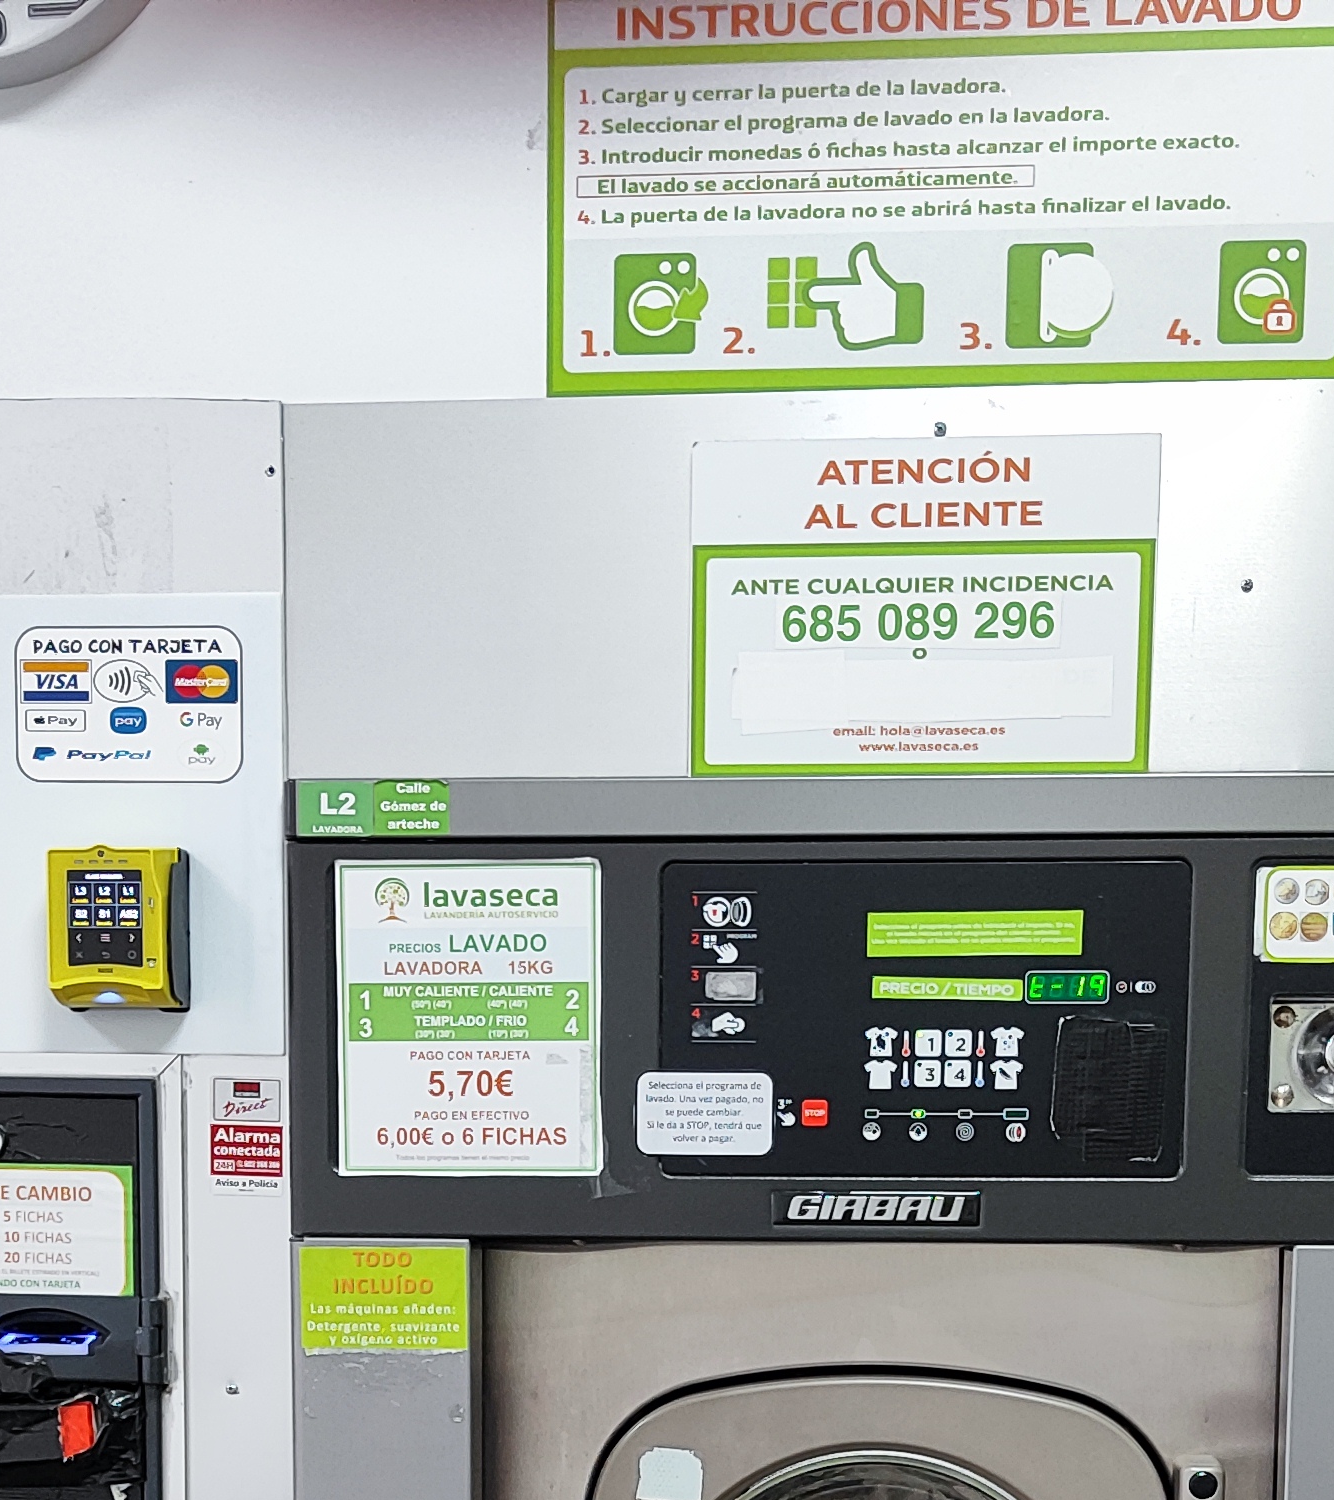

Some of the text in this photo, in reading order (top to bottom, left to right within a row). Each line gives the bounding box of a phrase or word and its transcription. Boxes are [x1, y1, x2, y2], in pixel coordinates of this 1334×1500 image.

[617, 0, 1301, 42] INSTRUCCIONES DE LAVADO
[580, 78, 1005, 107] 1. Cargar y cerrar la puerta de la lavadora.
[817, 451, 1030, 485] ATENCIÓN
[804, 501, 1042, 529] AL CLIENTE
[731, 575, 1113, 595] ANTE CUALQUIER INCIDENCIA
[783, 601, 1054, 642] 685 089 296
[33, 639, 222, 654] PAGO CON TARJETA
[35, 674, 78, 689] VISA
[48, 716, 77, 726] Pay
[115, 717, 141, 727] pay
[198, 713, 222, 730] Pay
[833, 726, 1005, 737] email: hola@lavaseca.es
[859, 742, 978, 751] www.lavaseca.es
[67, 750, 151, 761] PayPal
[396, 783, 430, 793] Calle
[320, 792, 356, 815] L2
[379, 800, 449, 813] Gómez de
[312, 825, 363, 833] LAVADORA
[387, 818, 441, 831] arteche
[424, 882, 558, 907] lavaseca
[389, 934, 546, 953] PRECIOS LAVADO
[384, 961, 552, 975] LAVADORA 15KG
[428, 1070, 513, 1101] 5,70€
[215, 1128, 280, 1144] Alarma
[378, 1127, 566, 1148] 6,00€ o 6 FICHAS
[214, 1144, 280, 1157] conectada
[16, 1186, 91, 1201] CAMBIO
[787, 1195, 965, 1221] GIRBAU
[4, 1211, 10, 1222] 5
[16, 1211, 63, 1223] FICHAS
[353, 1251, 412, 1267] TODO
[334, 1275, 433, 1294] INCLUÍDO
